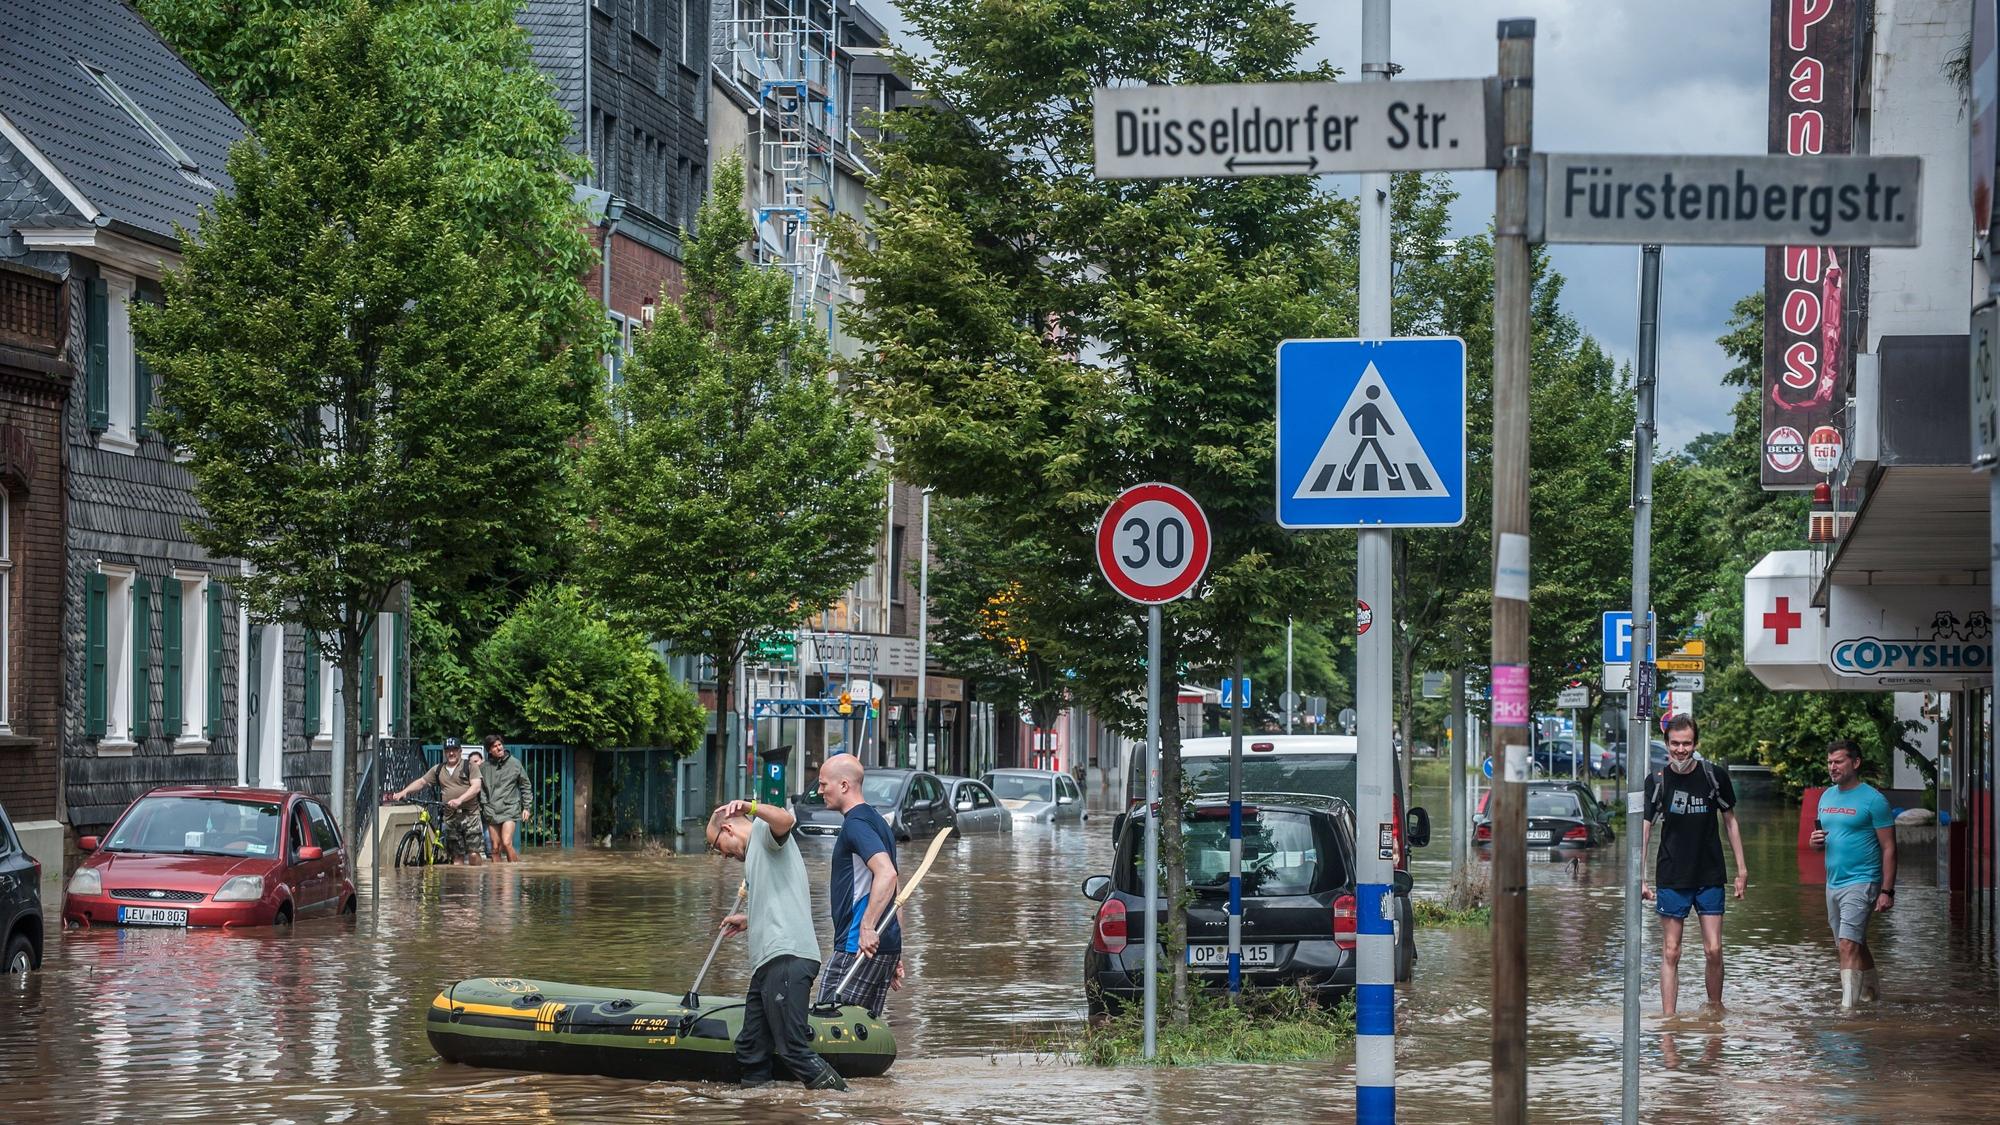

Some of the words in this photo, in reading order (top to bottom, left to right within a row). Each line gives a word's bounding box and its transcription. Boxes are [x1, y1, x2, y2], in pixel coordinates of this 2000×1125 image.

[1115, 104, 1359, 157] Düsseldorfer
[1387, 102, 1459, 150] Str.
[1564, 166, 1905, 237] Fürstenbergstr.
[1767, 445, 1804, 453] BECK'S
[1122, 517, 1184, 569] 30
[771, 764, 780, 778] P
[1823, 807, 1857, 816] HEAD
[125, 908, 145, 920] LEV
[151, 909, 165, 921] HO
[167, 910, 186, 922] 803
[1195, 946, 1215, 962] OP
[1249, 946, 1268, 961] 15
